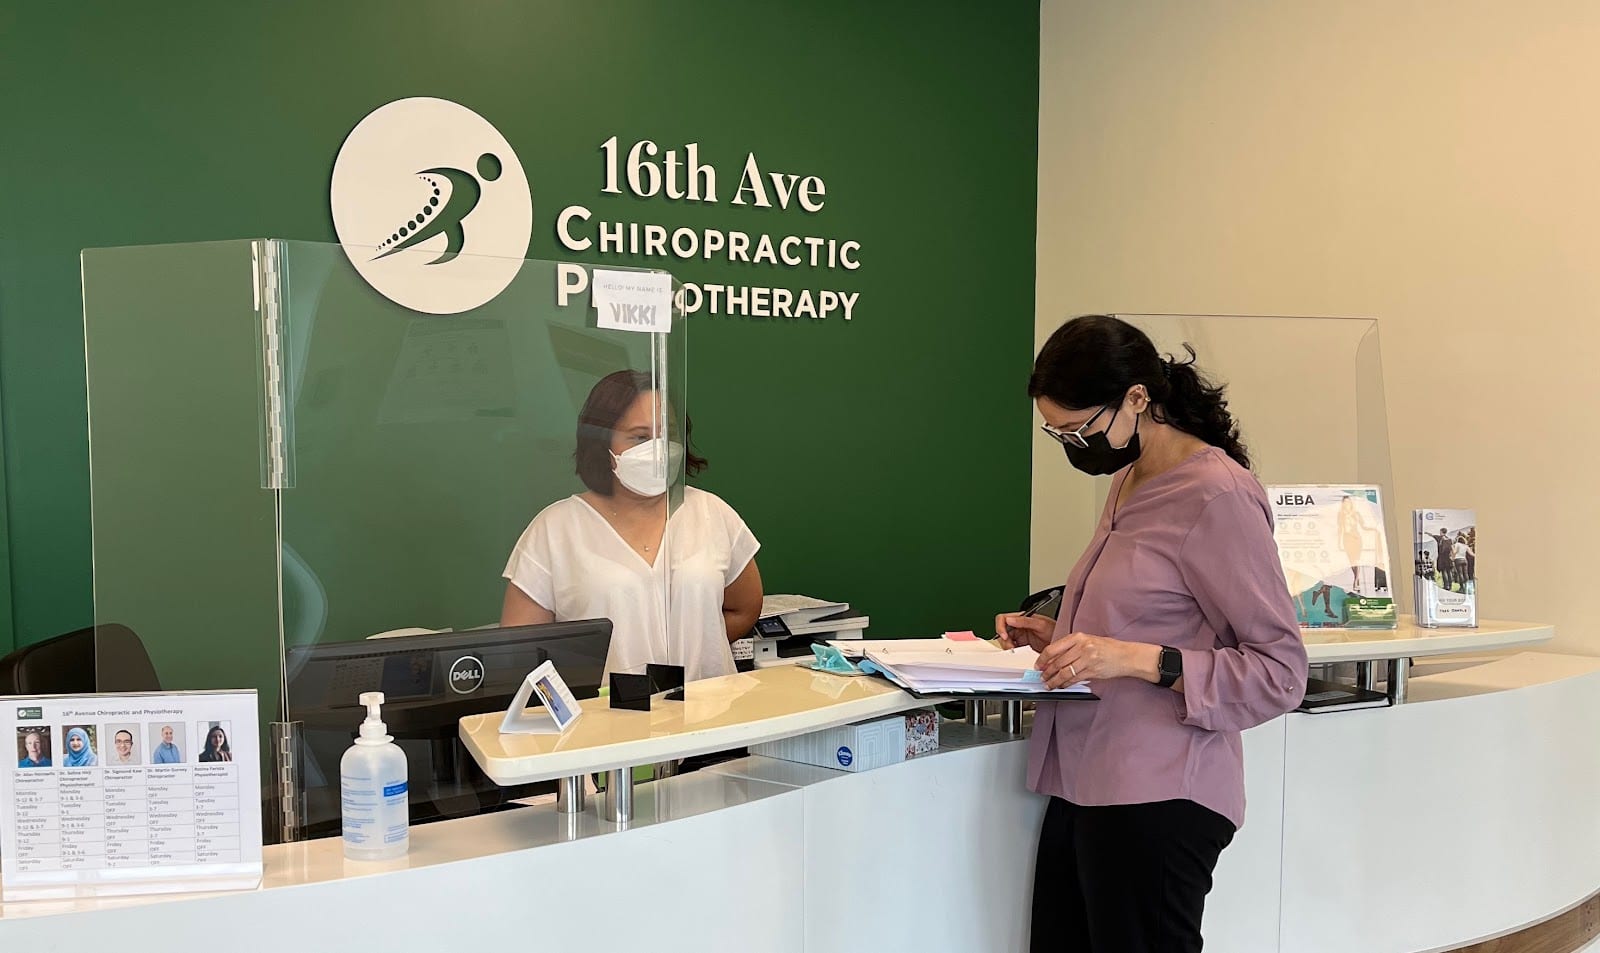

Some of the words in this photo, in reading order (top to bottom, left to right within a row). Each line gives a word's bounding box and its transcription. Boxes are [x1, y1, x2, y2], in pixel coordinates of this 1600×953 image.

[600, 136, 718, 202] 16th
[730, 152, 826, 212] Ave
[556, 205, 861, 270] CHIROPRACTIC
[557, 263, 860, 320] POTHERAPY
[609, 302, 657, 326] VIKKI
[1276, 494, 1315, 505] JEBA
[453, 669, 481, 681] DELL
[96, 709, 130, 717] Chiropractic
